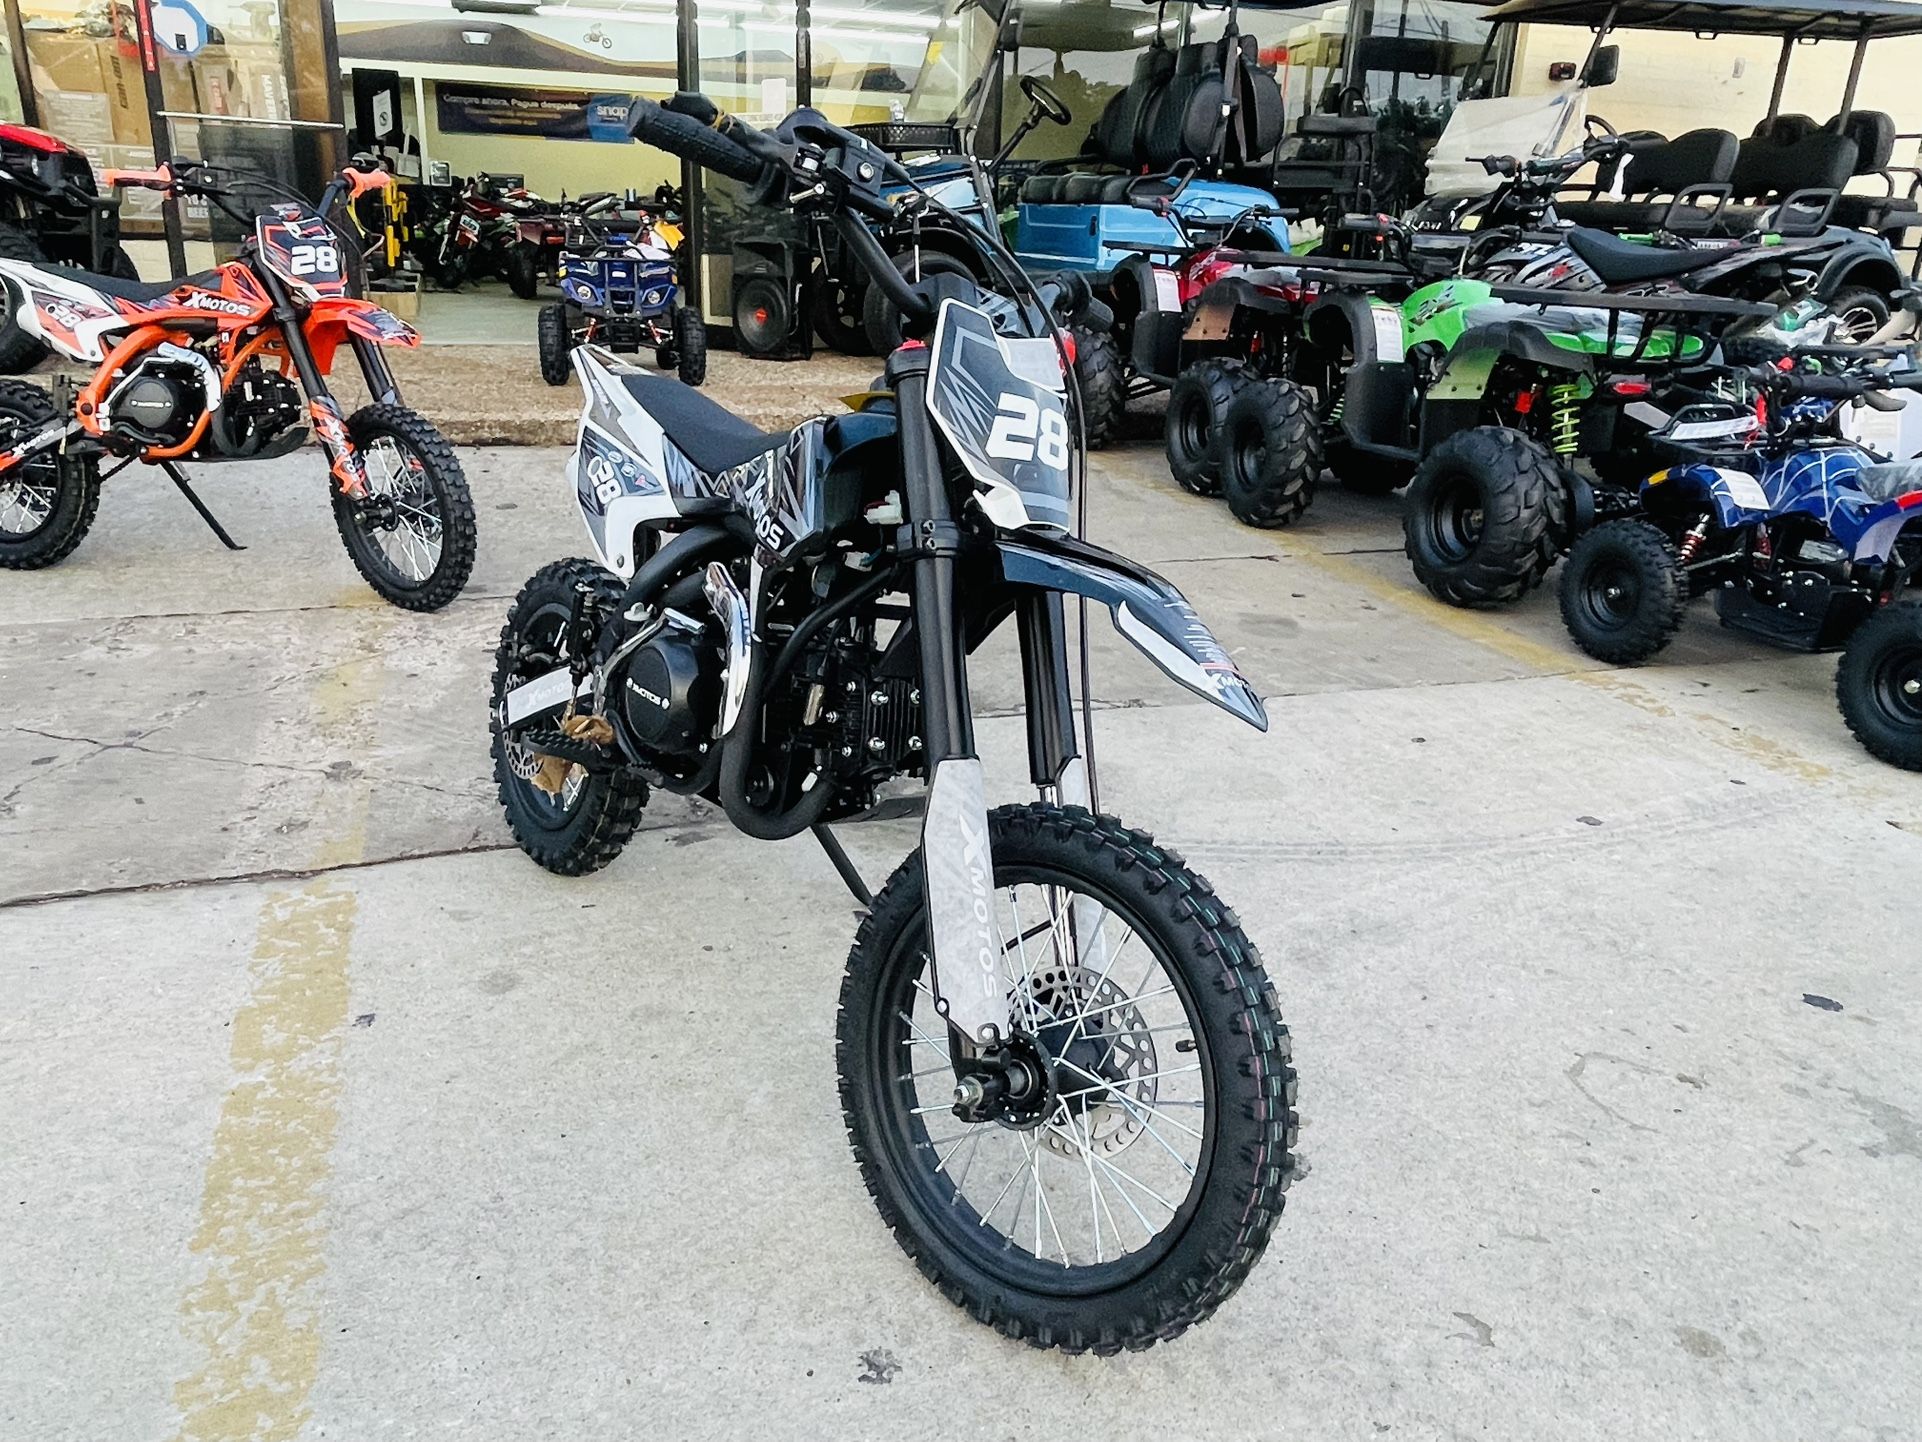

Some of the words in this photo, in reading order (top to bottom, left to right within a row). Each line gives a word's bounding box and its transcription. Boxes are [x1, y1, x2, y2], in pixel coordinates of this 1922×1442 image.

[597, 105, 630, 121] snap
[290, 245, 339, 276] 28
[183, 291, 251, 317] XMOTOS
[985, 391, 1069, 471] 28
[958, 814, 998, 999] XMOTOS
